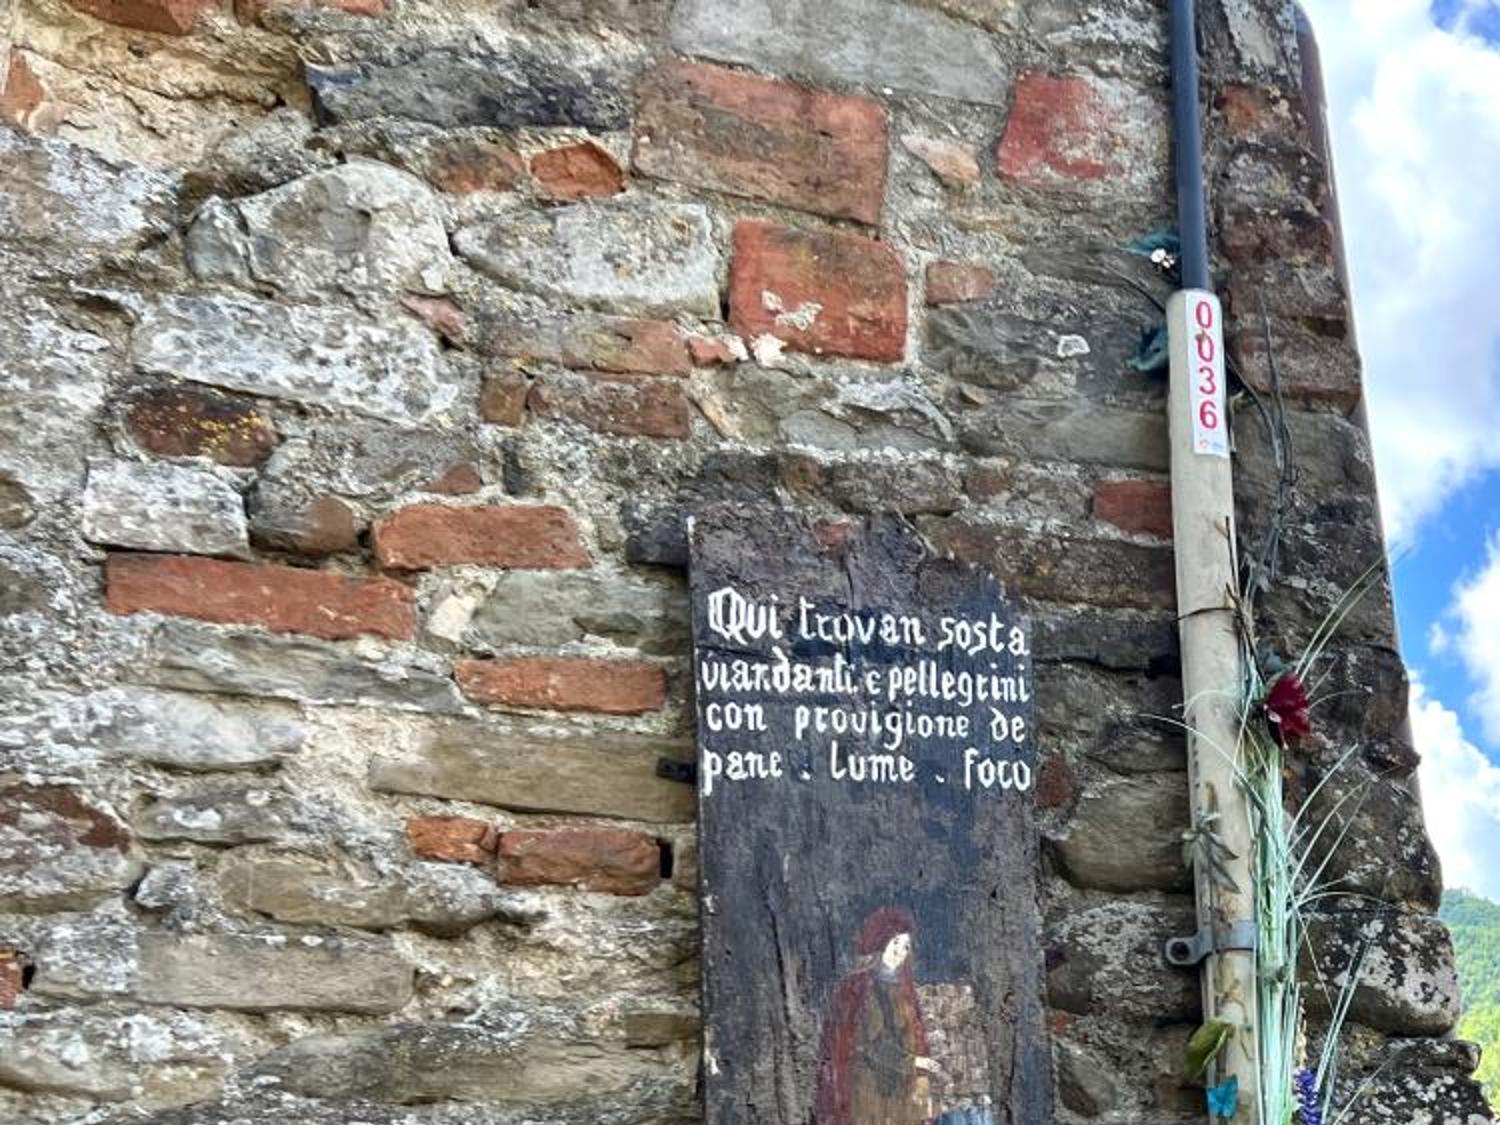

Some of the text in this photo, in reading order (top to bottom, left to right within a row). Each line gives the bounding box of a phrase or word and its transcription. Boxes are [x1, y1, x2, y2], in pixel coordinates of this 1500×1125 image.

[1195, 301, 1218, 429] 0036
[706, 586, 1031, 656] Qui trovan sosta
[865, 670, 881, 695] e
[888, 660, 1031, 707] pellegrini
[706, 700, 1026, 750] con provigione de
[964, 748, 1032, 791] foco
